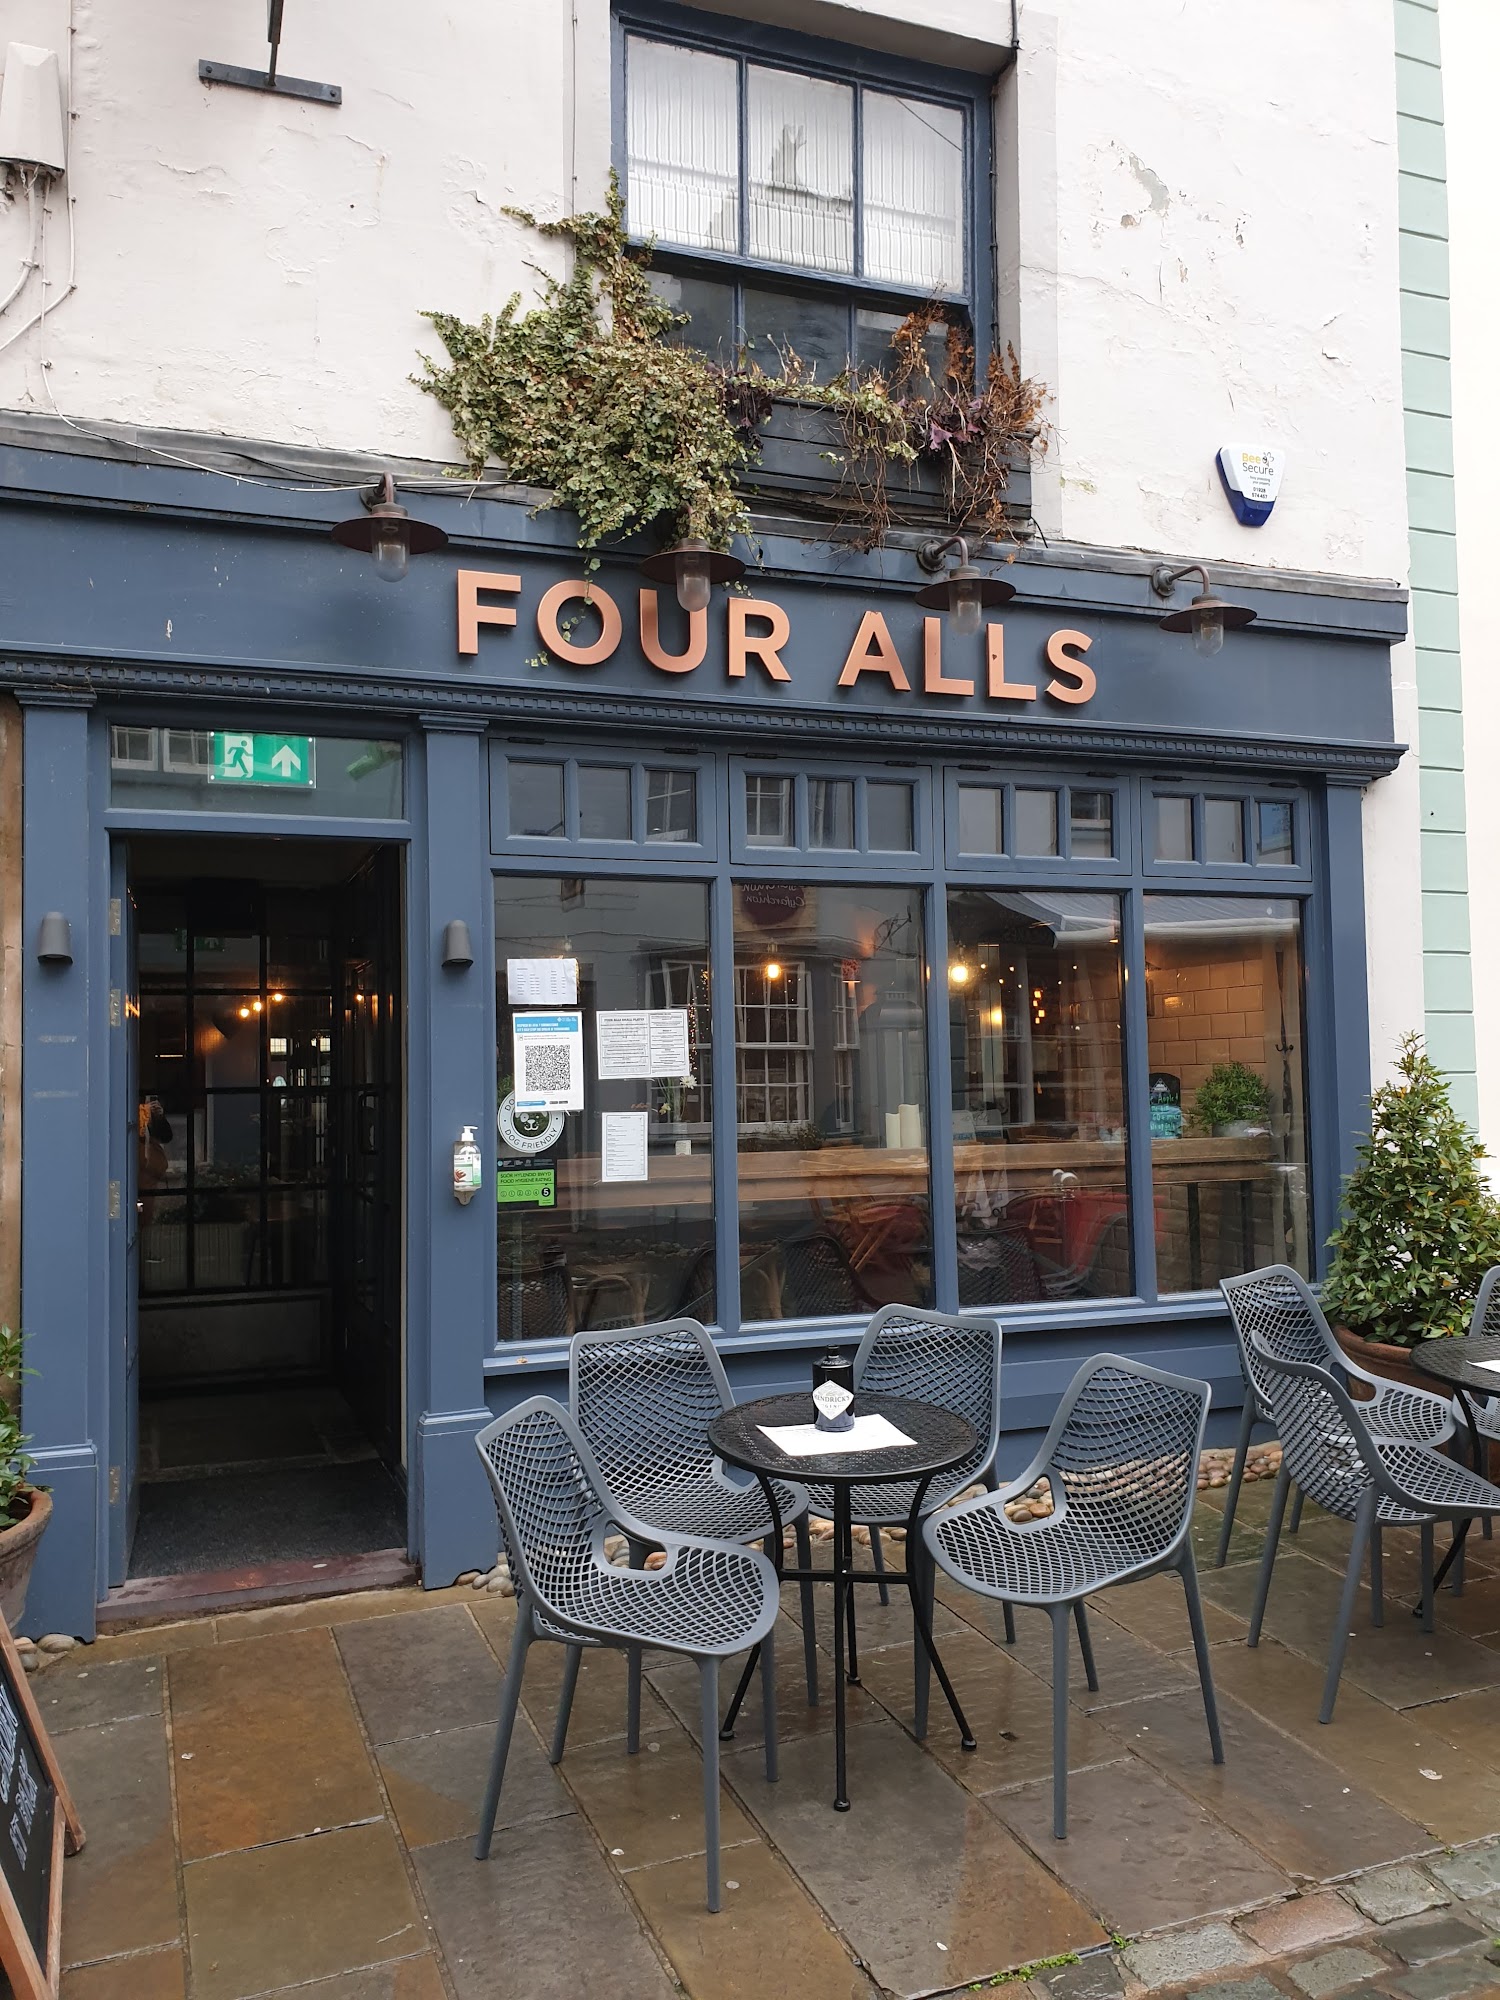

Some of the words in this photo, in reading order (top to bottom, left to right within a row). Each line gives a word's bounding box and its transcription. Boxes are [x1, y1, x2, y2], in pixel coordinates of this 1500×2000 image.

[1242, 453, 1261, 464] Bee
[1242, 462, 1274, 475] Secure
[456, 568, 792, 682] FOUR
[837, 609, 1098, 705] ALLS
[504, 1099, 515, 1111] DO
[504, 1129, 520, 1145] DOG
[521, 1127, 557, 1149] FRIENDLY
[15, 1748, 38, 1835] BACK
[9, 1812, 27, 1872] AT
